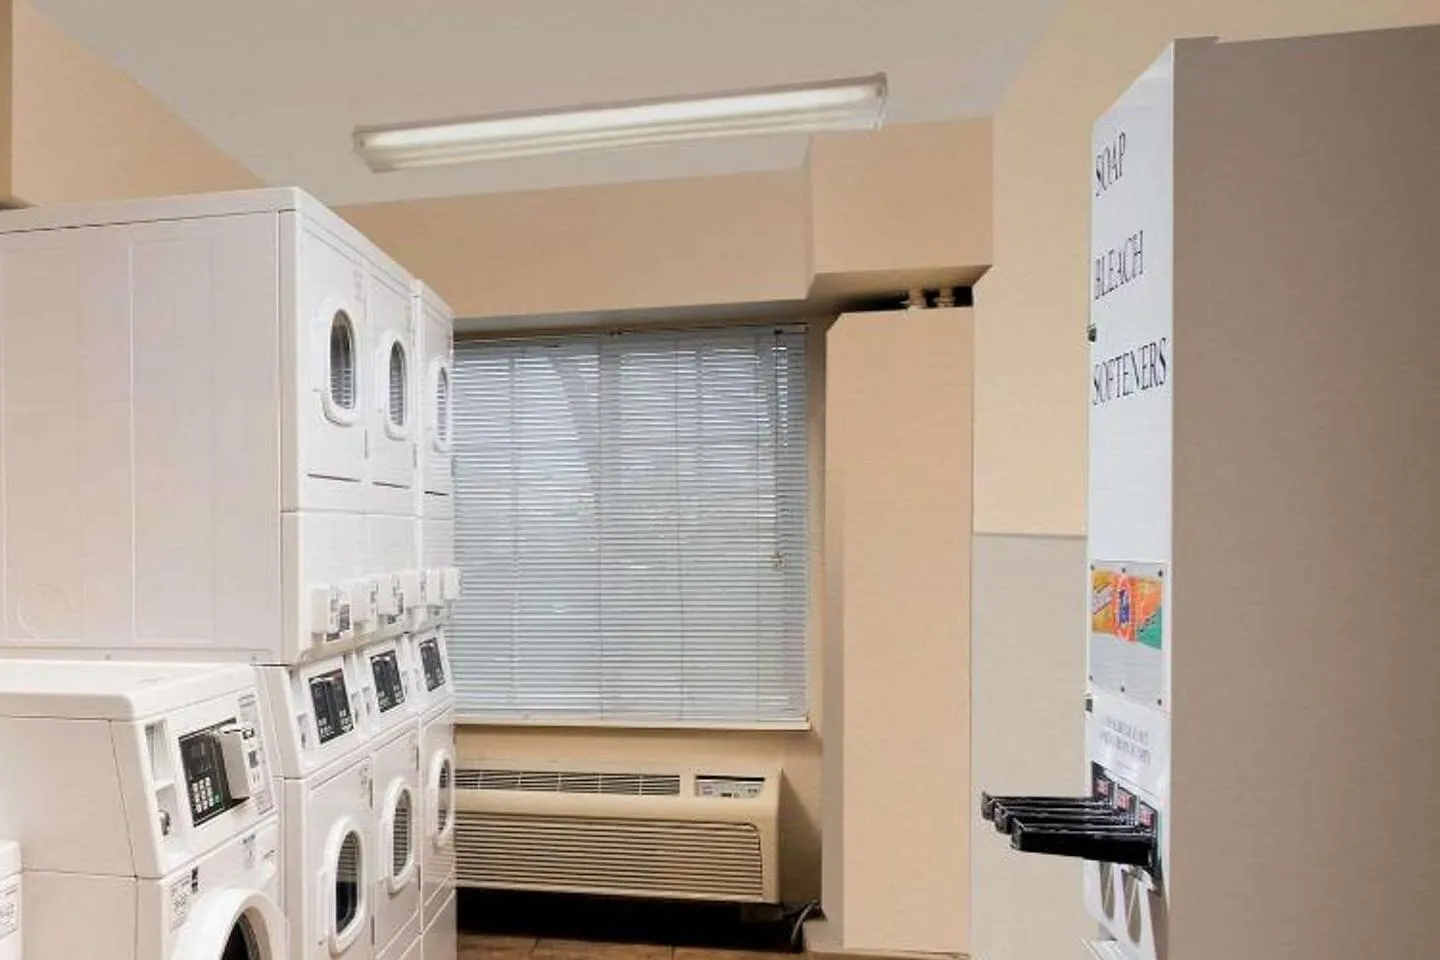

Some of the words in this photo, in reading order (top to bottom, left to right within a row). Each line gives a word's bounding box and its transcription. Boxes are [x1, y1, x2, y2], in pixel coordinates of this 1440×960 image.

[1095, 131, 1126, 197] SOAP
[1095, 229, 1144, 301] BLEACH
[1093, 336, 1168, 405] SOFTENERS
